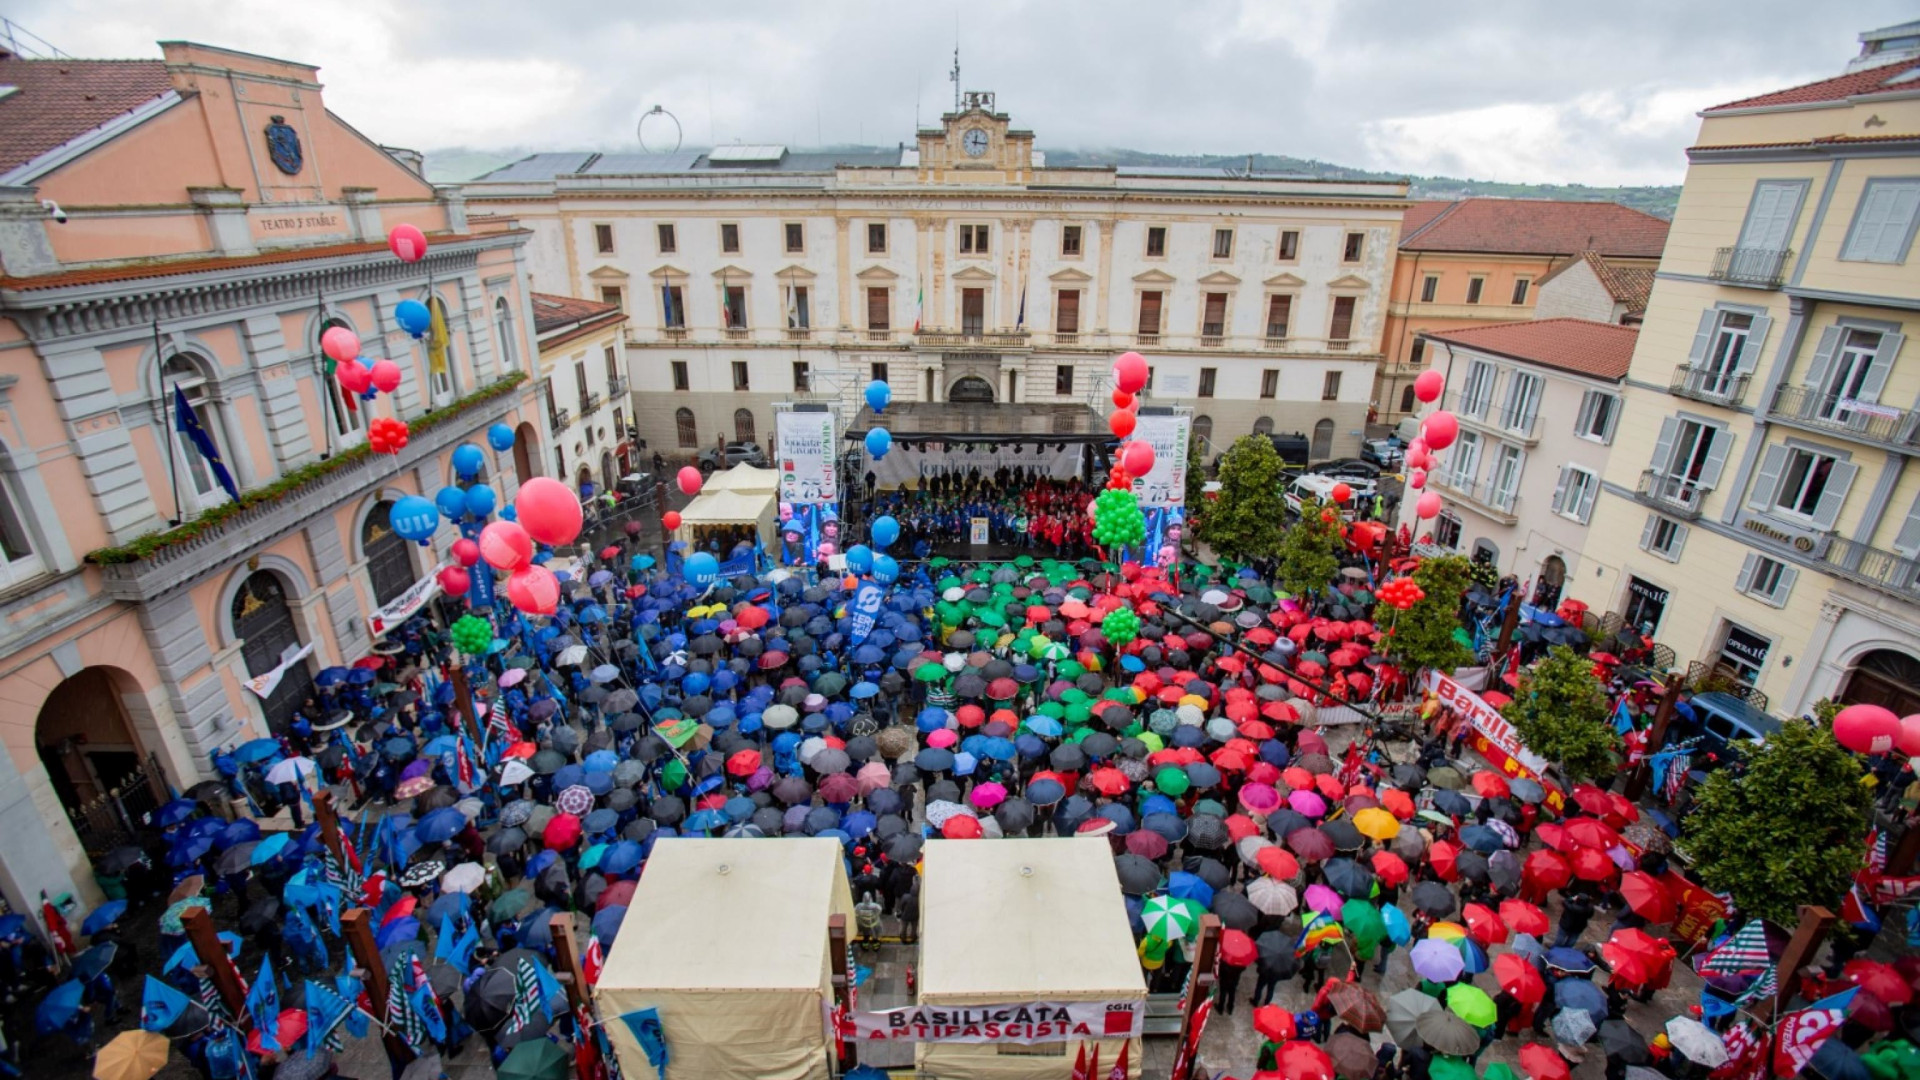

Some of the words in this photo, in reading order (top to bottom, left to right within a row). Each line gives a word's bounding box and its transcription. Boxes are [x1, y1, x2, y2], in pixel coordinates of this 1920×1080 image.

[261, 219, 295, 230] TEATRO
[395, 513, 435, 533] UIL
[1437, 679, 1522, 755] Barilla
[888, 1006, 1073, 1028] BASILICATA
[1106, 1003, 1134, 1011] CGIL
[869, 1021, 1092, 1041] ANTIFASCISTA
[1782, 1016, 1797, 1054] POTENZ
